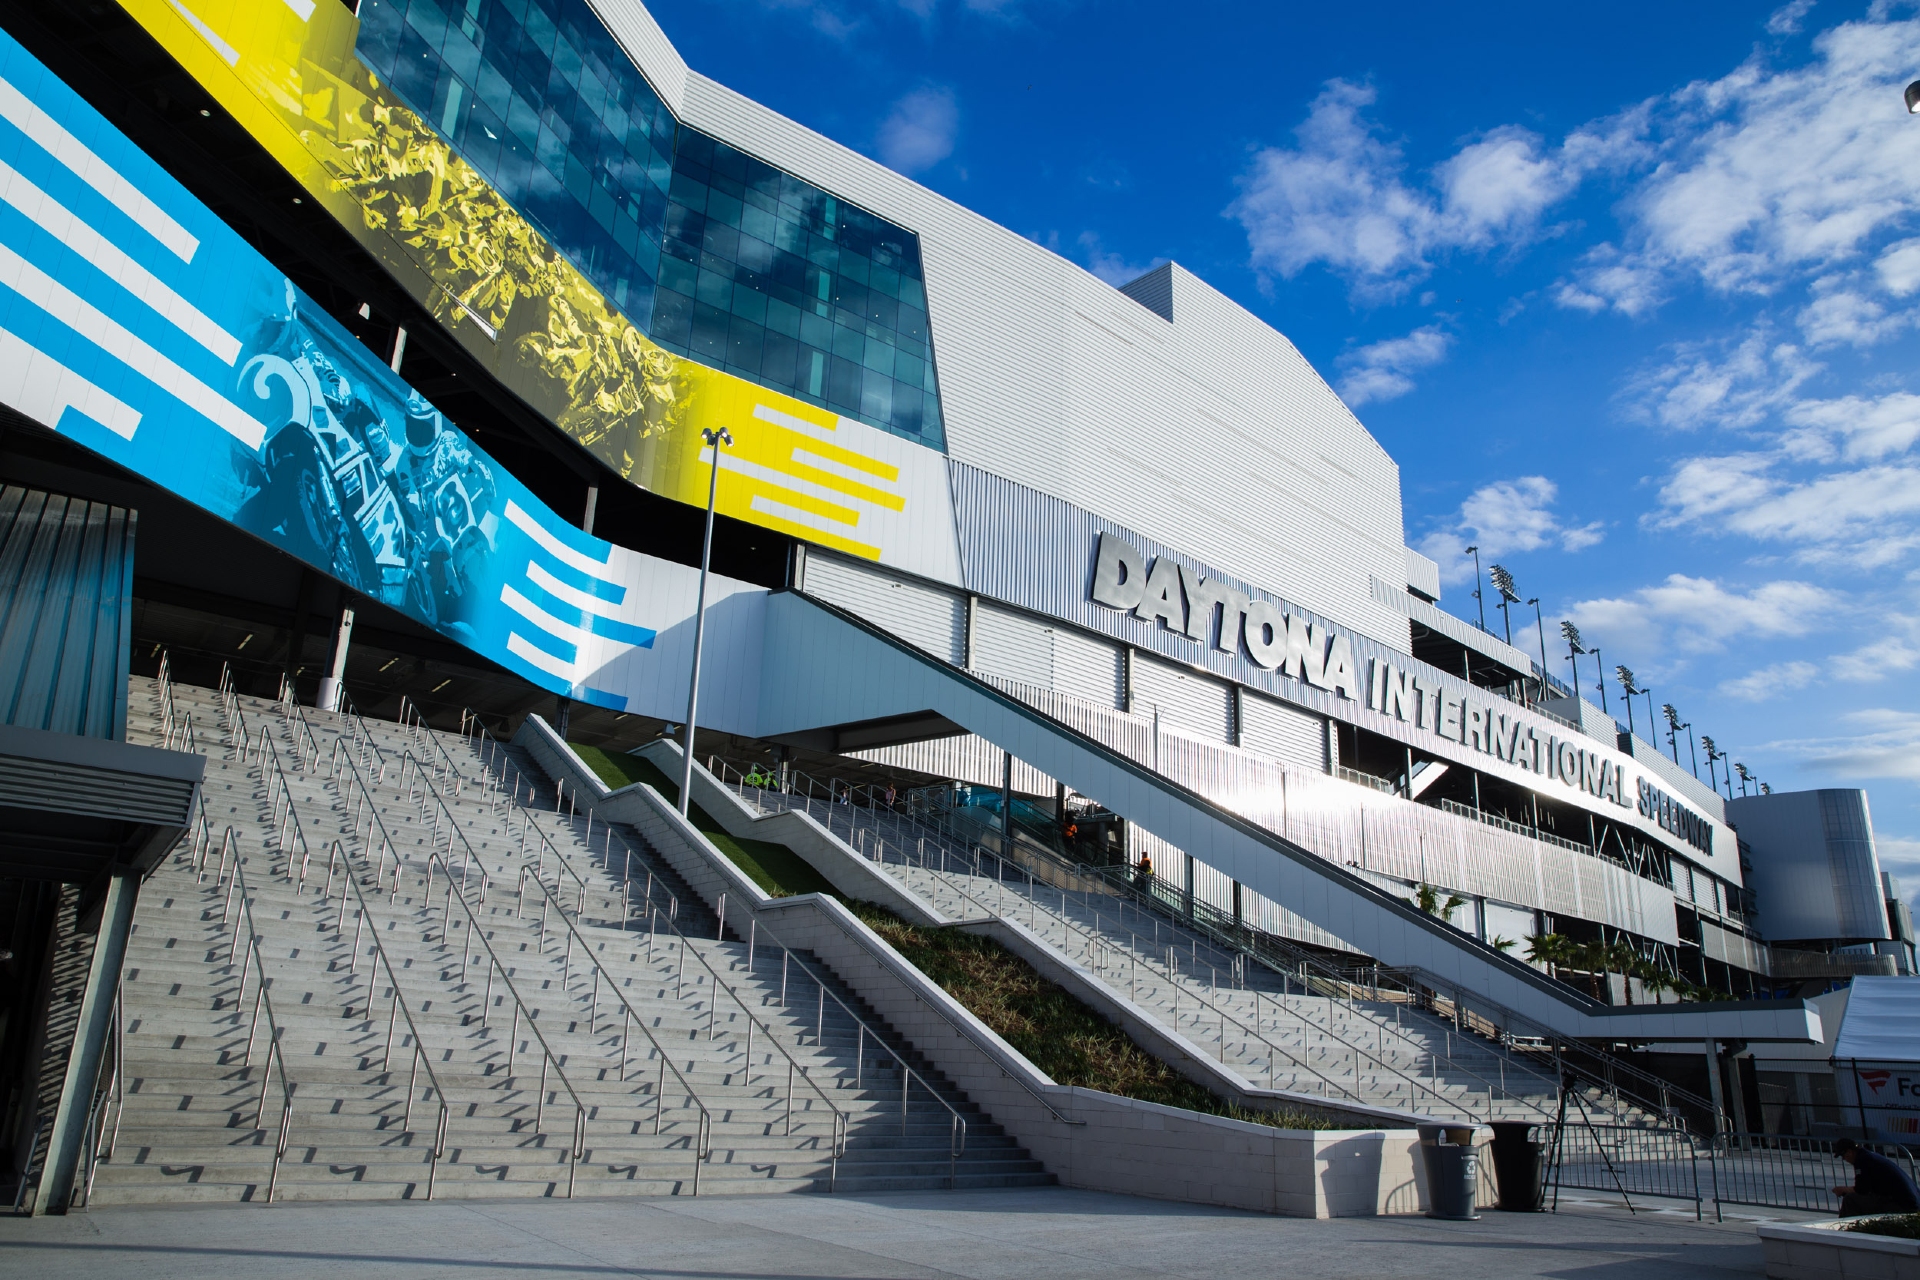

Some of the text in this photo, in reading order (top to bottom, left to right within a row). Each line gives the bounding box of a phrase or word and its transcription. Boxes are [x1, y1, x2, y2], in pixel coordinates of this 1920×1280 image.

[1092, 530, 1713, 857] DAYTONA INTERNATIONAL SPEEDWAY
